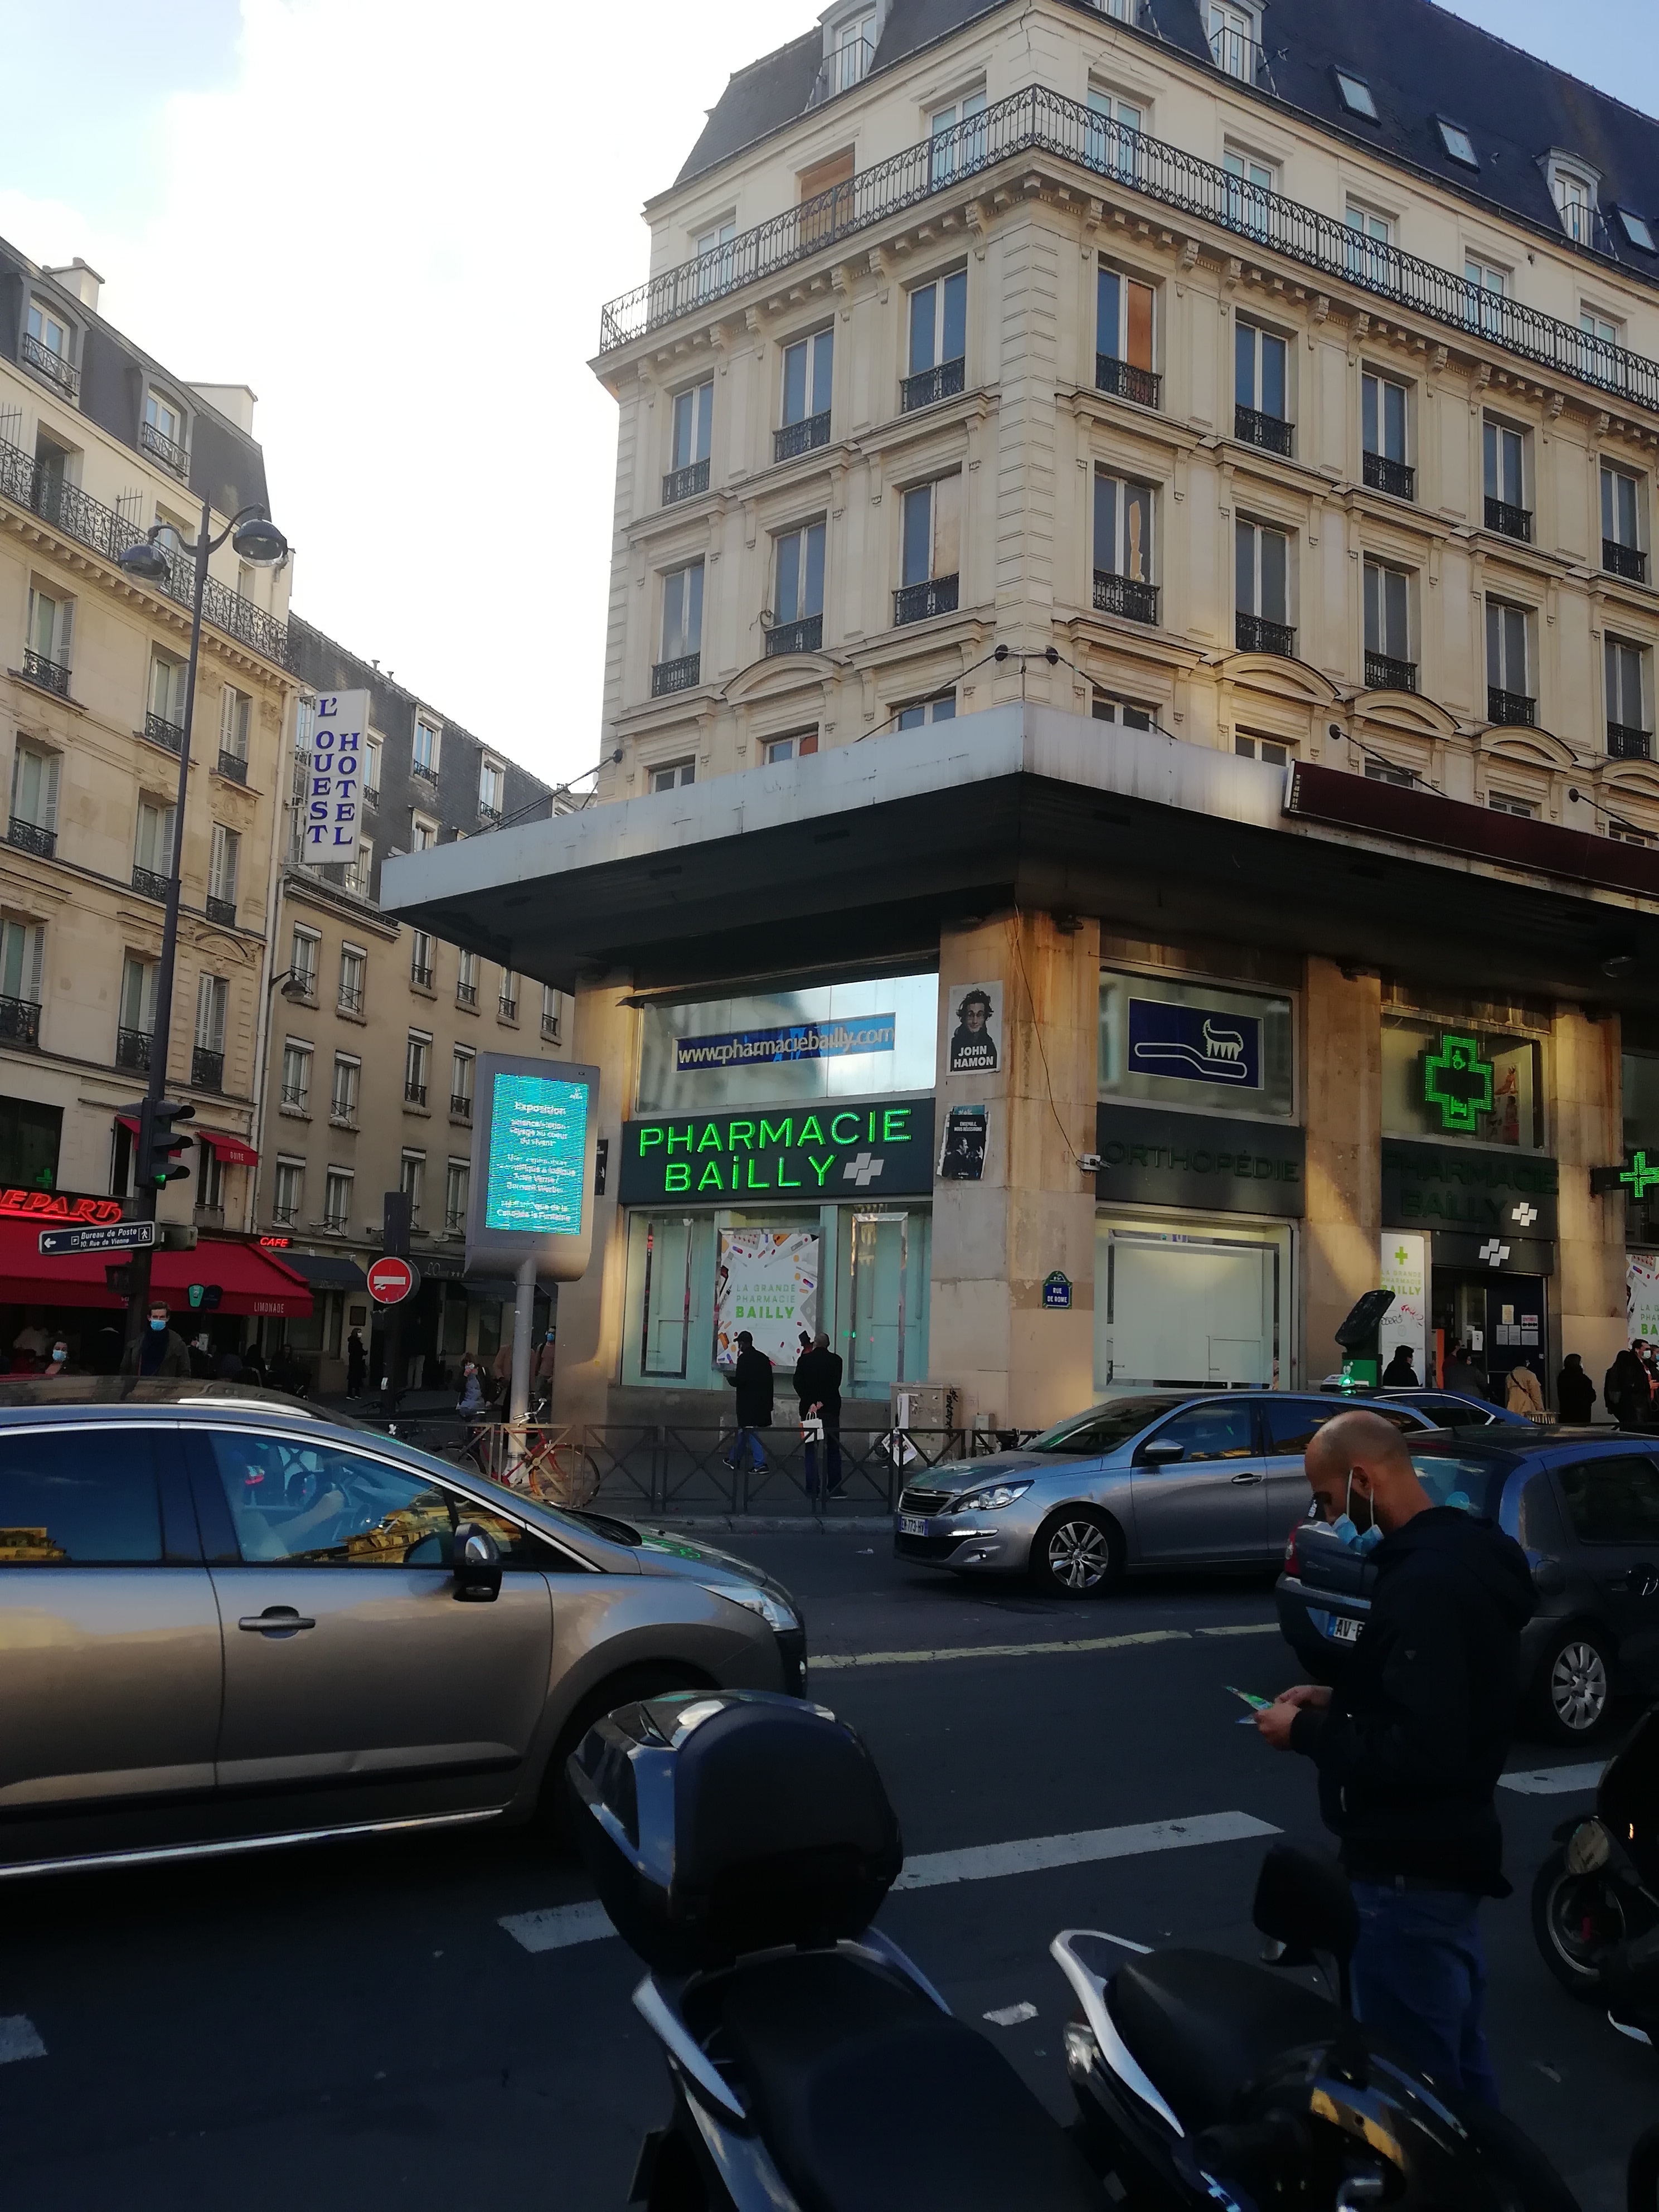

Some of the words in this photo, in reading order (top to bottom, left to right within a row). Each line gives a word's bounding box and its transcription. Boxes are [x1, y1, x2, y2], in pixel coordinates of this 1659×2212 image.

[333, 732, 360, 845] HOTEL
[958, 1045, 987, 1056] JOHN
[954, 1056, 993, 1068] HAMON
[639, 1108, 912, 1157] PHARMACIE
[1102, 1139, 1301, 1182] ORTHOPÉDIE
[0, 1188, 123, 1226] EPART
[81, 1231, 104, 1240] Bureau
[107, 1229, 115, 1238] de
[118, 1228, 137, 1236] Poste
[1381, 1277, 1421, 1285] PHARMACIE
[736, 1284, 749, 1292] LA
[754, 1284, 796, 1292] GRANDE
[736, 1295, 795, 1303] PHARMACIE
[254, 1302, 285, 1313] LIMONADE
[736, 1306, 794, 1319] BAILLY
